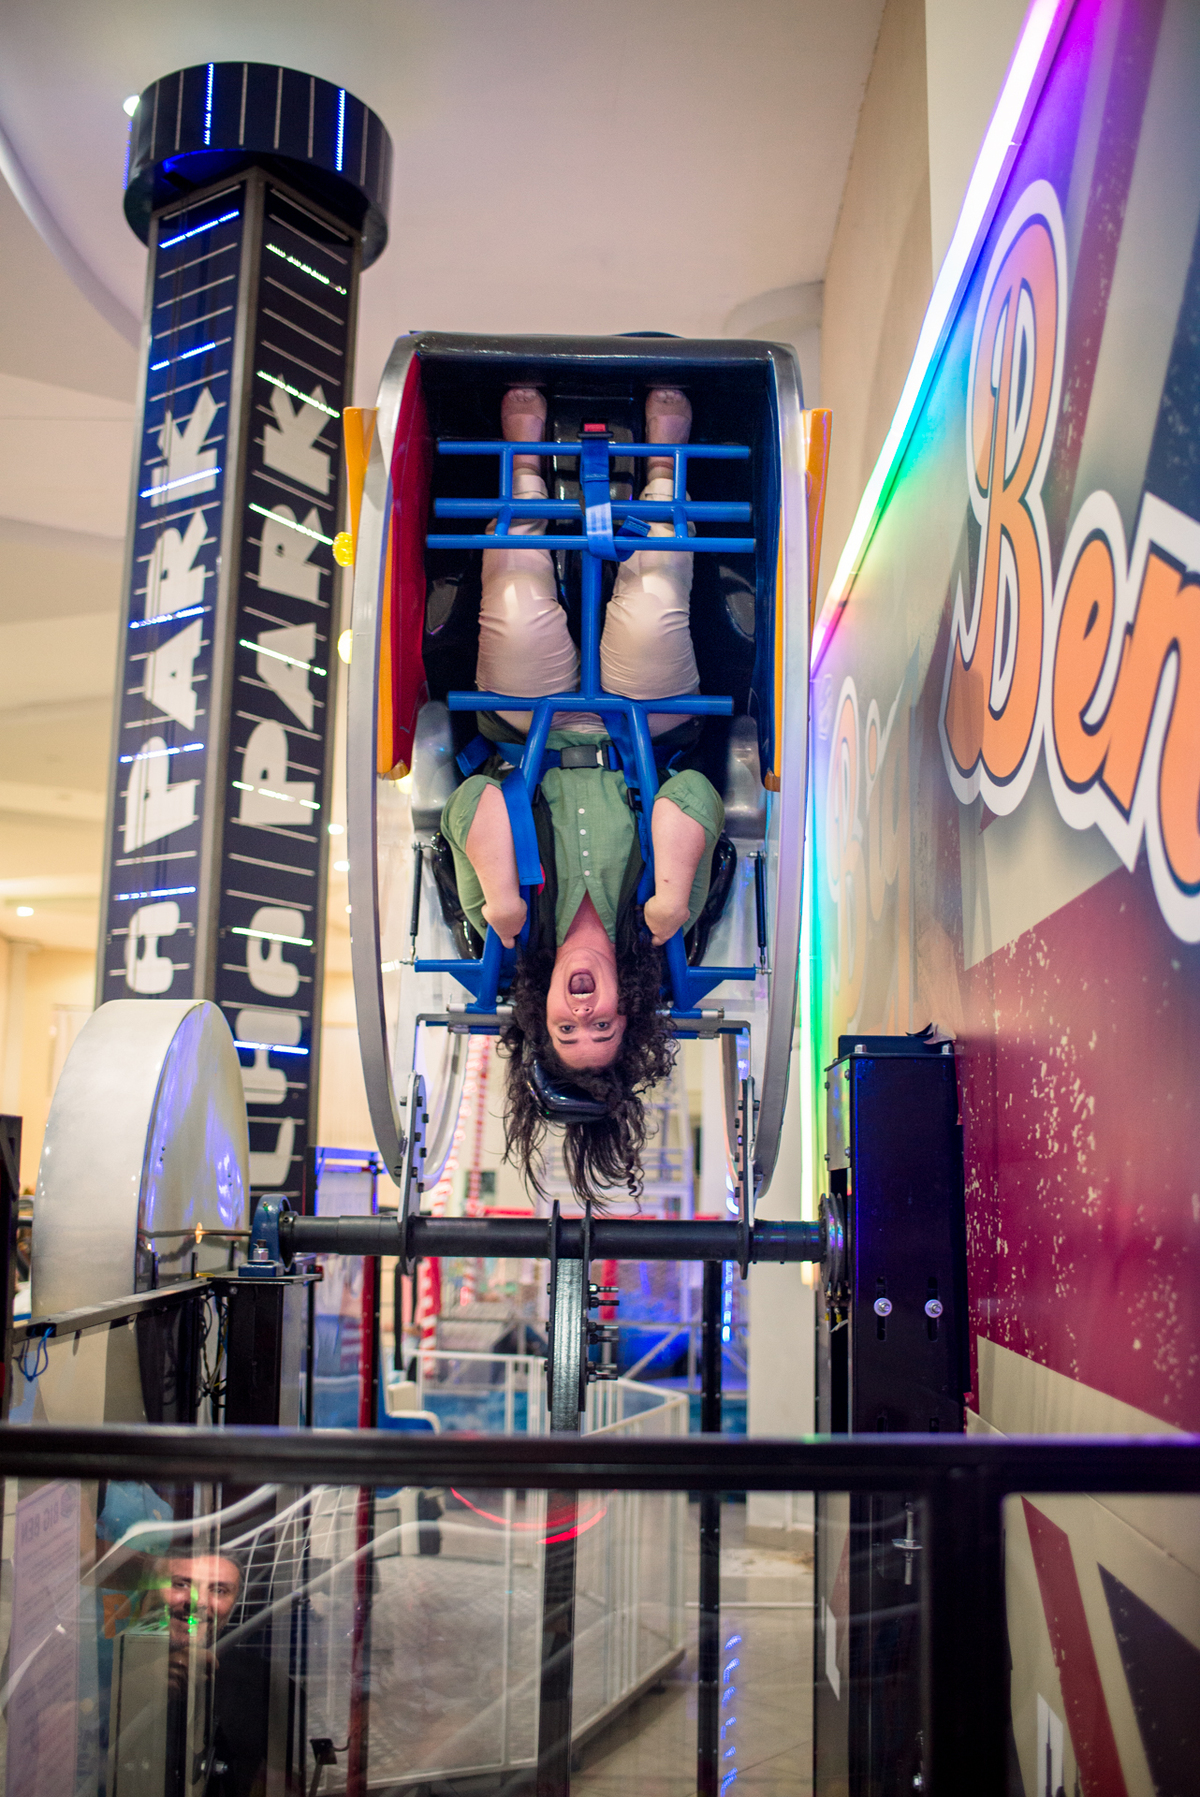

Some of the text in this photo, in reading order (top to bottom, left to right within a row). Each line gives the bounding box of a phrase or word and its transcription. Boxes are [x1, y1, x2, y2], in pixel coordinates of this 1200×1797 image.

[123, 386, 218, 854] PARK
[239, 375, 333, 826] PARK
[938, 179, 1200, 945] Ben
